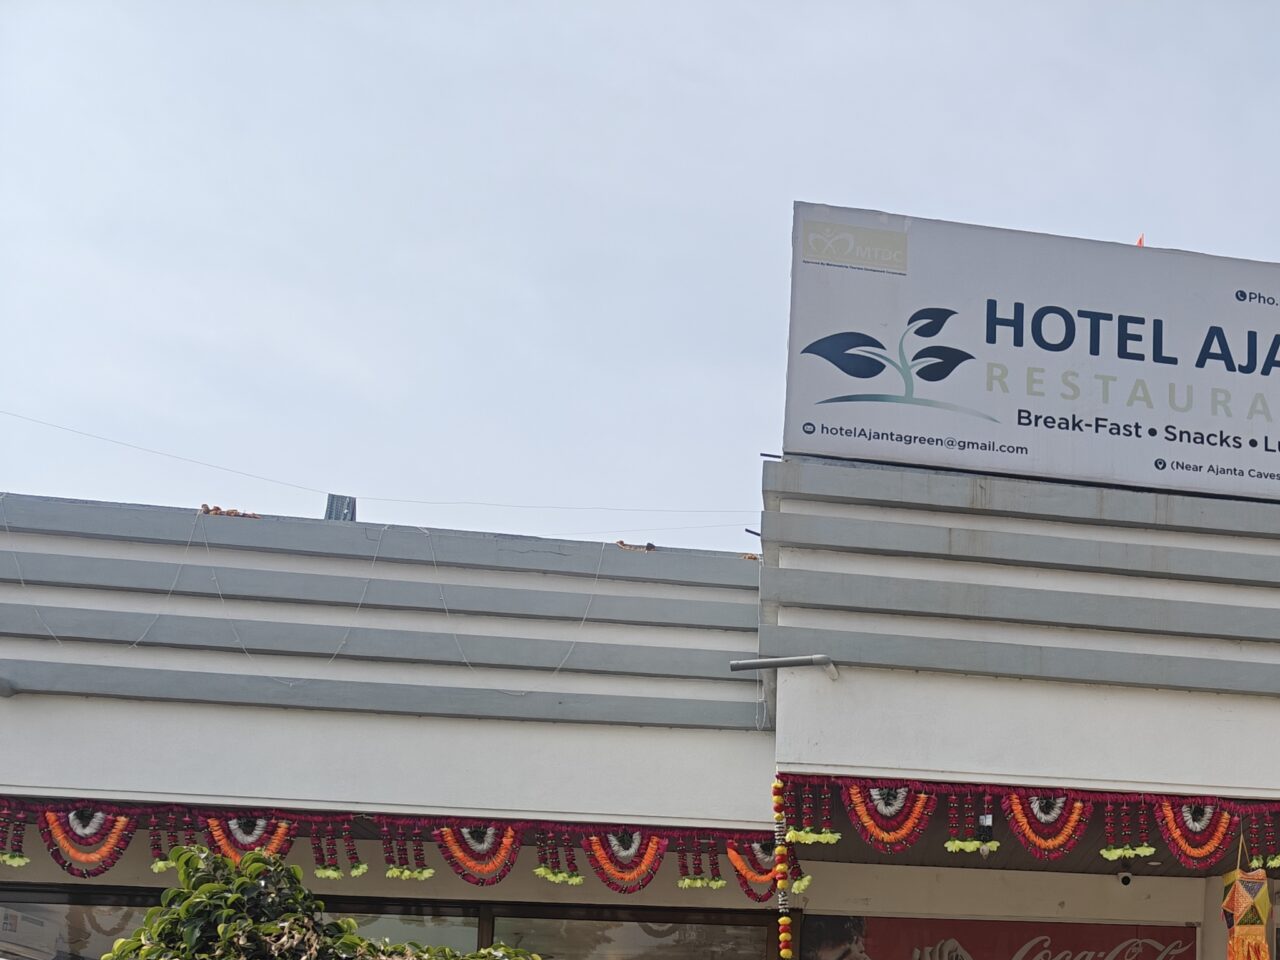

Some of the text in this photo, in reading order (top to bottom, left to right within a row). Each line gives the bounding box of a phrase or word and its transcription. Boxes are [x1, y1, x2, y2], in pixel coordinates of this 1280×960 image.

[985, 298, 1178, 366] HOTEL
[820, 422, 1029, 456] hotelAjantagreen@gmail.com
[1017, 408, 1142, 439] Break-Fast
[1164, 424, 1242, 449] Snacks
[1170, 460, 1203, 474] (Near
[1207, 464, 1245, 479] Ajanta
